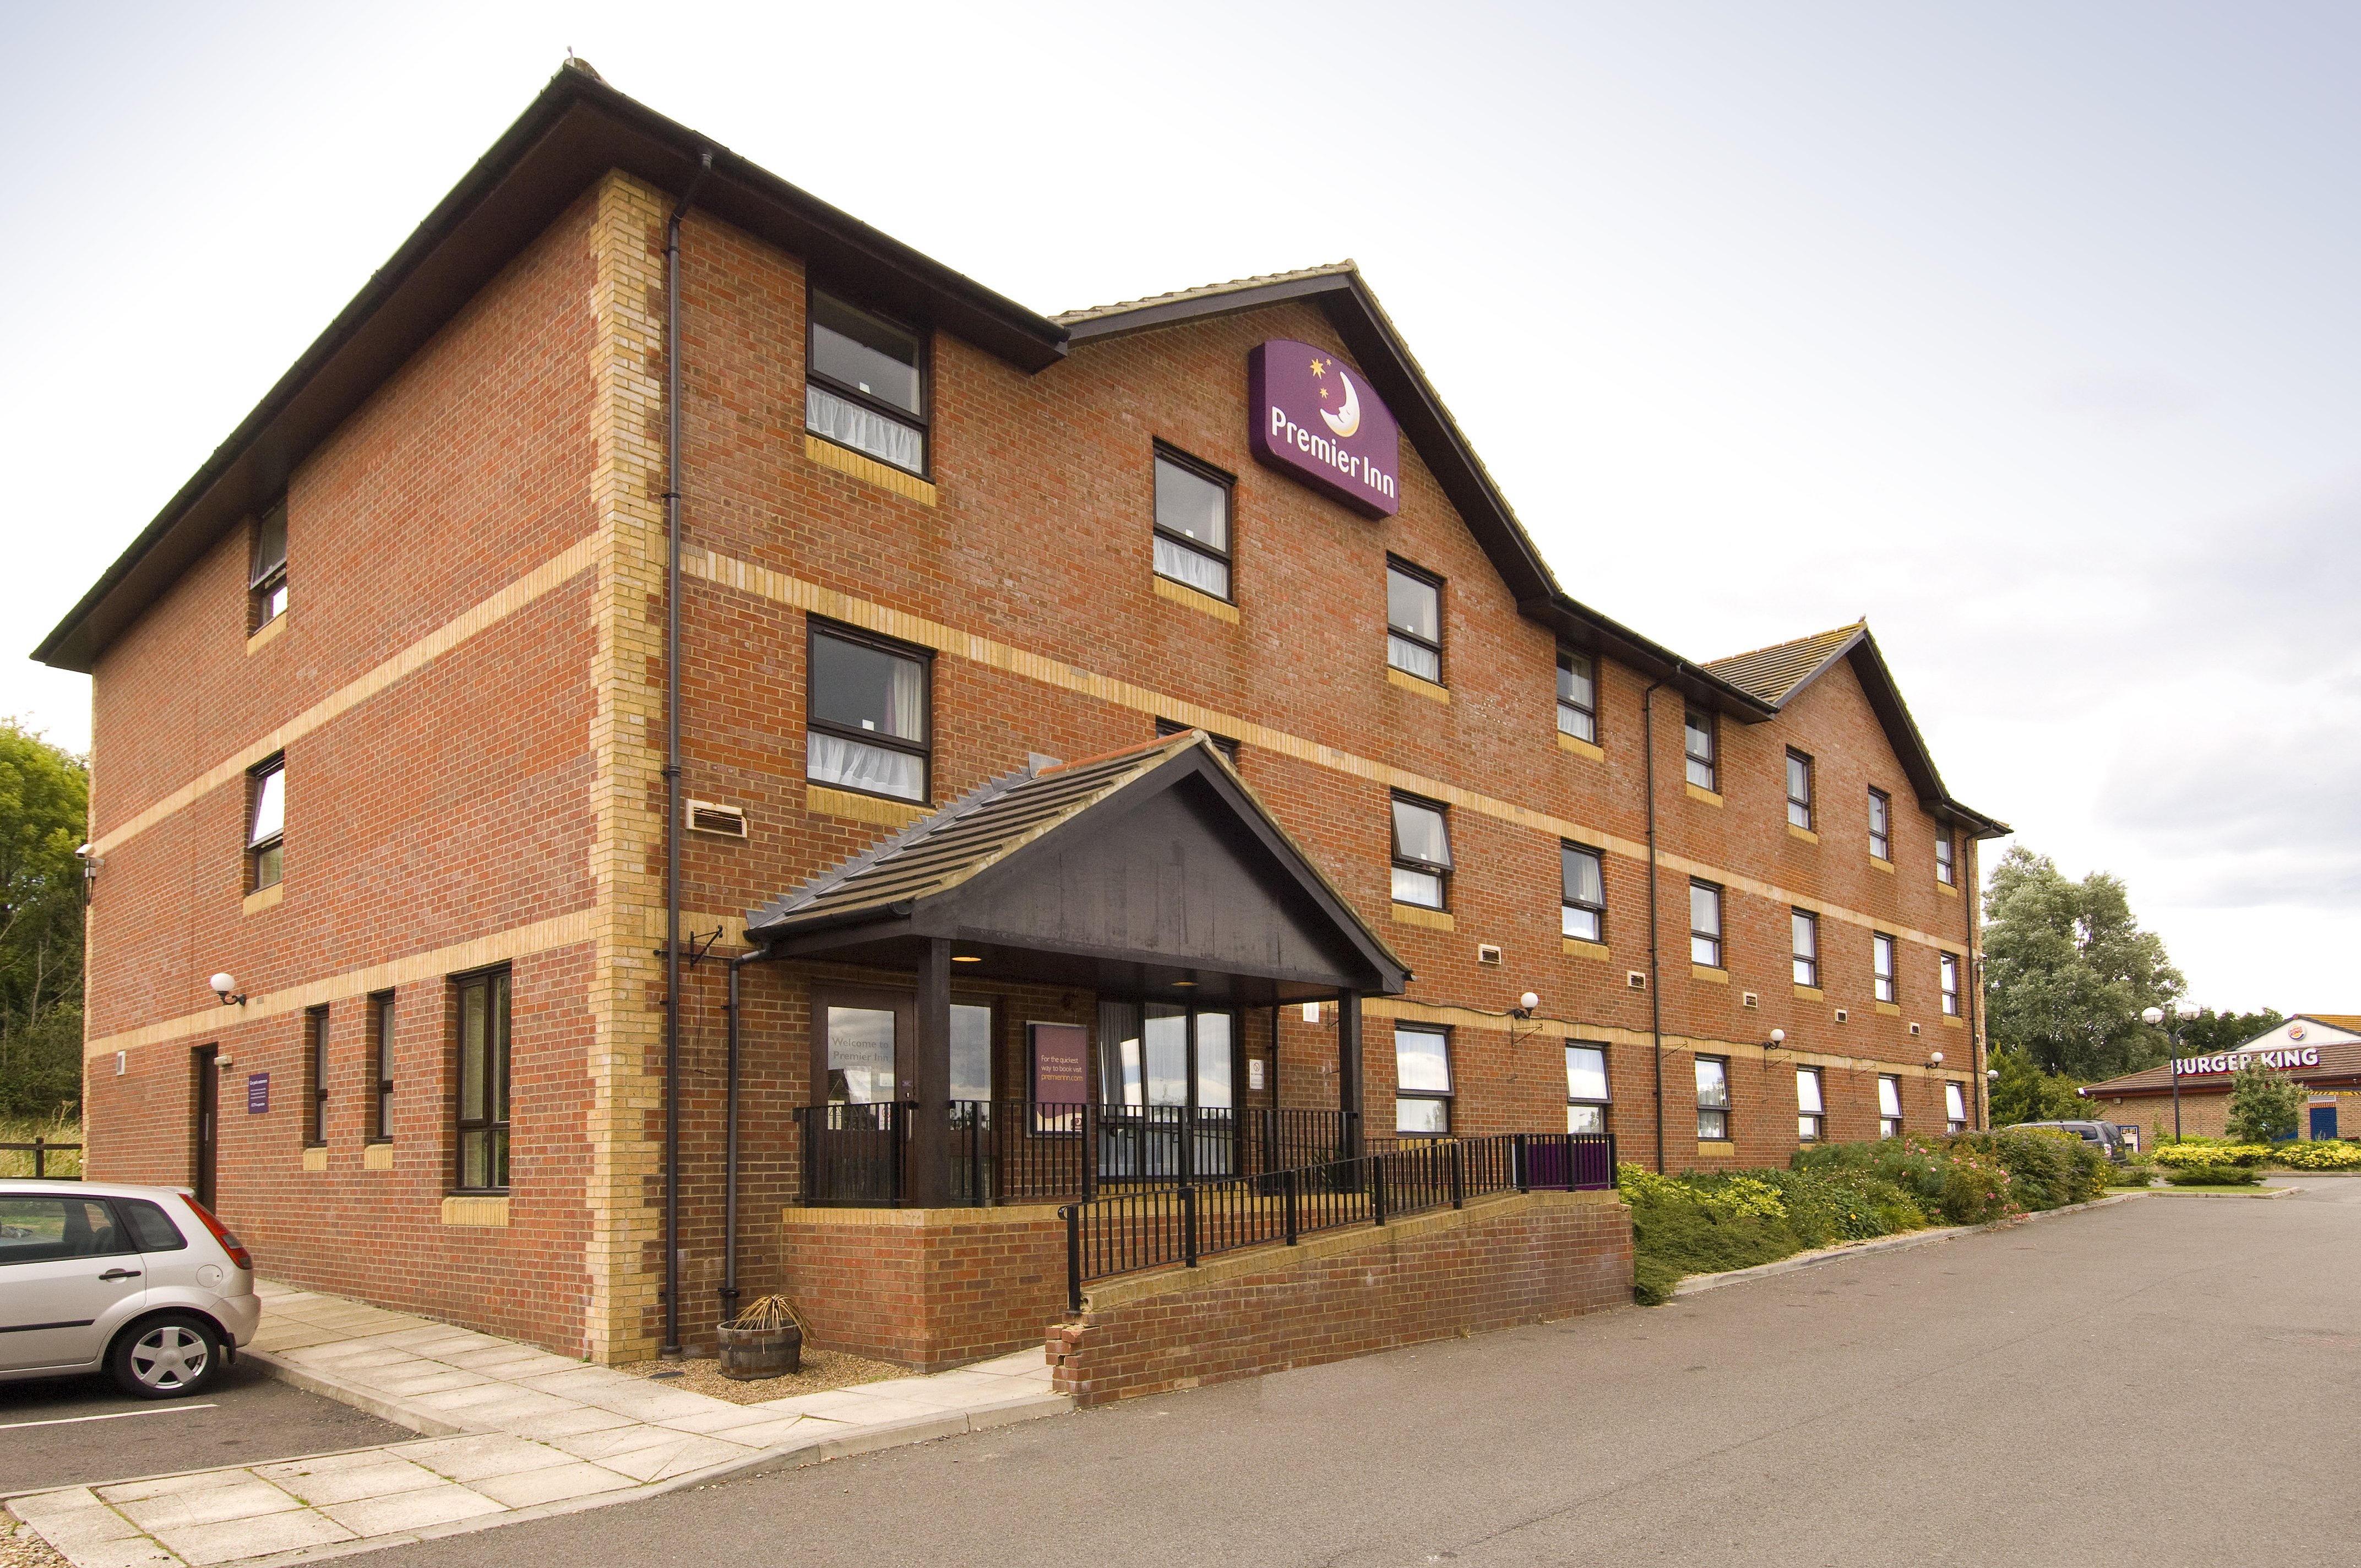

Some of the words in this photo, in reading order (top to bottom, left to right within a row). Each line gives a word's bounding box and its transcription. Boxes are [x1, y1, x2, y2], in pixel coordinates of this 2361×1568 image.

[1272, 406, 1360, 477] Premier
[1363, 456, 1394, 498] Inn
[832, 1037, 877, 1048] Welcome
[833, 1051, 872, 1061] Premier
[874, 1053, 888, 1061] Inn
[2260, 1048, 2320, 1068] KING
